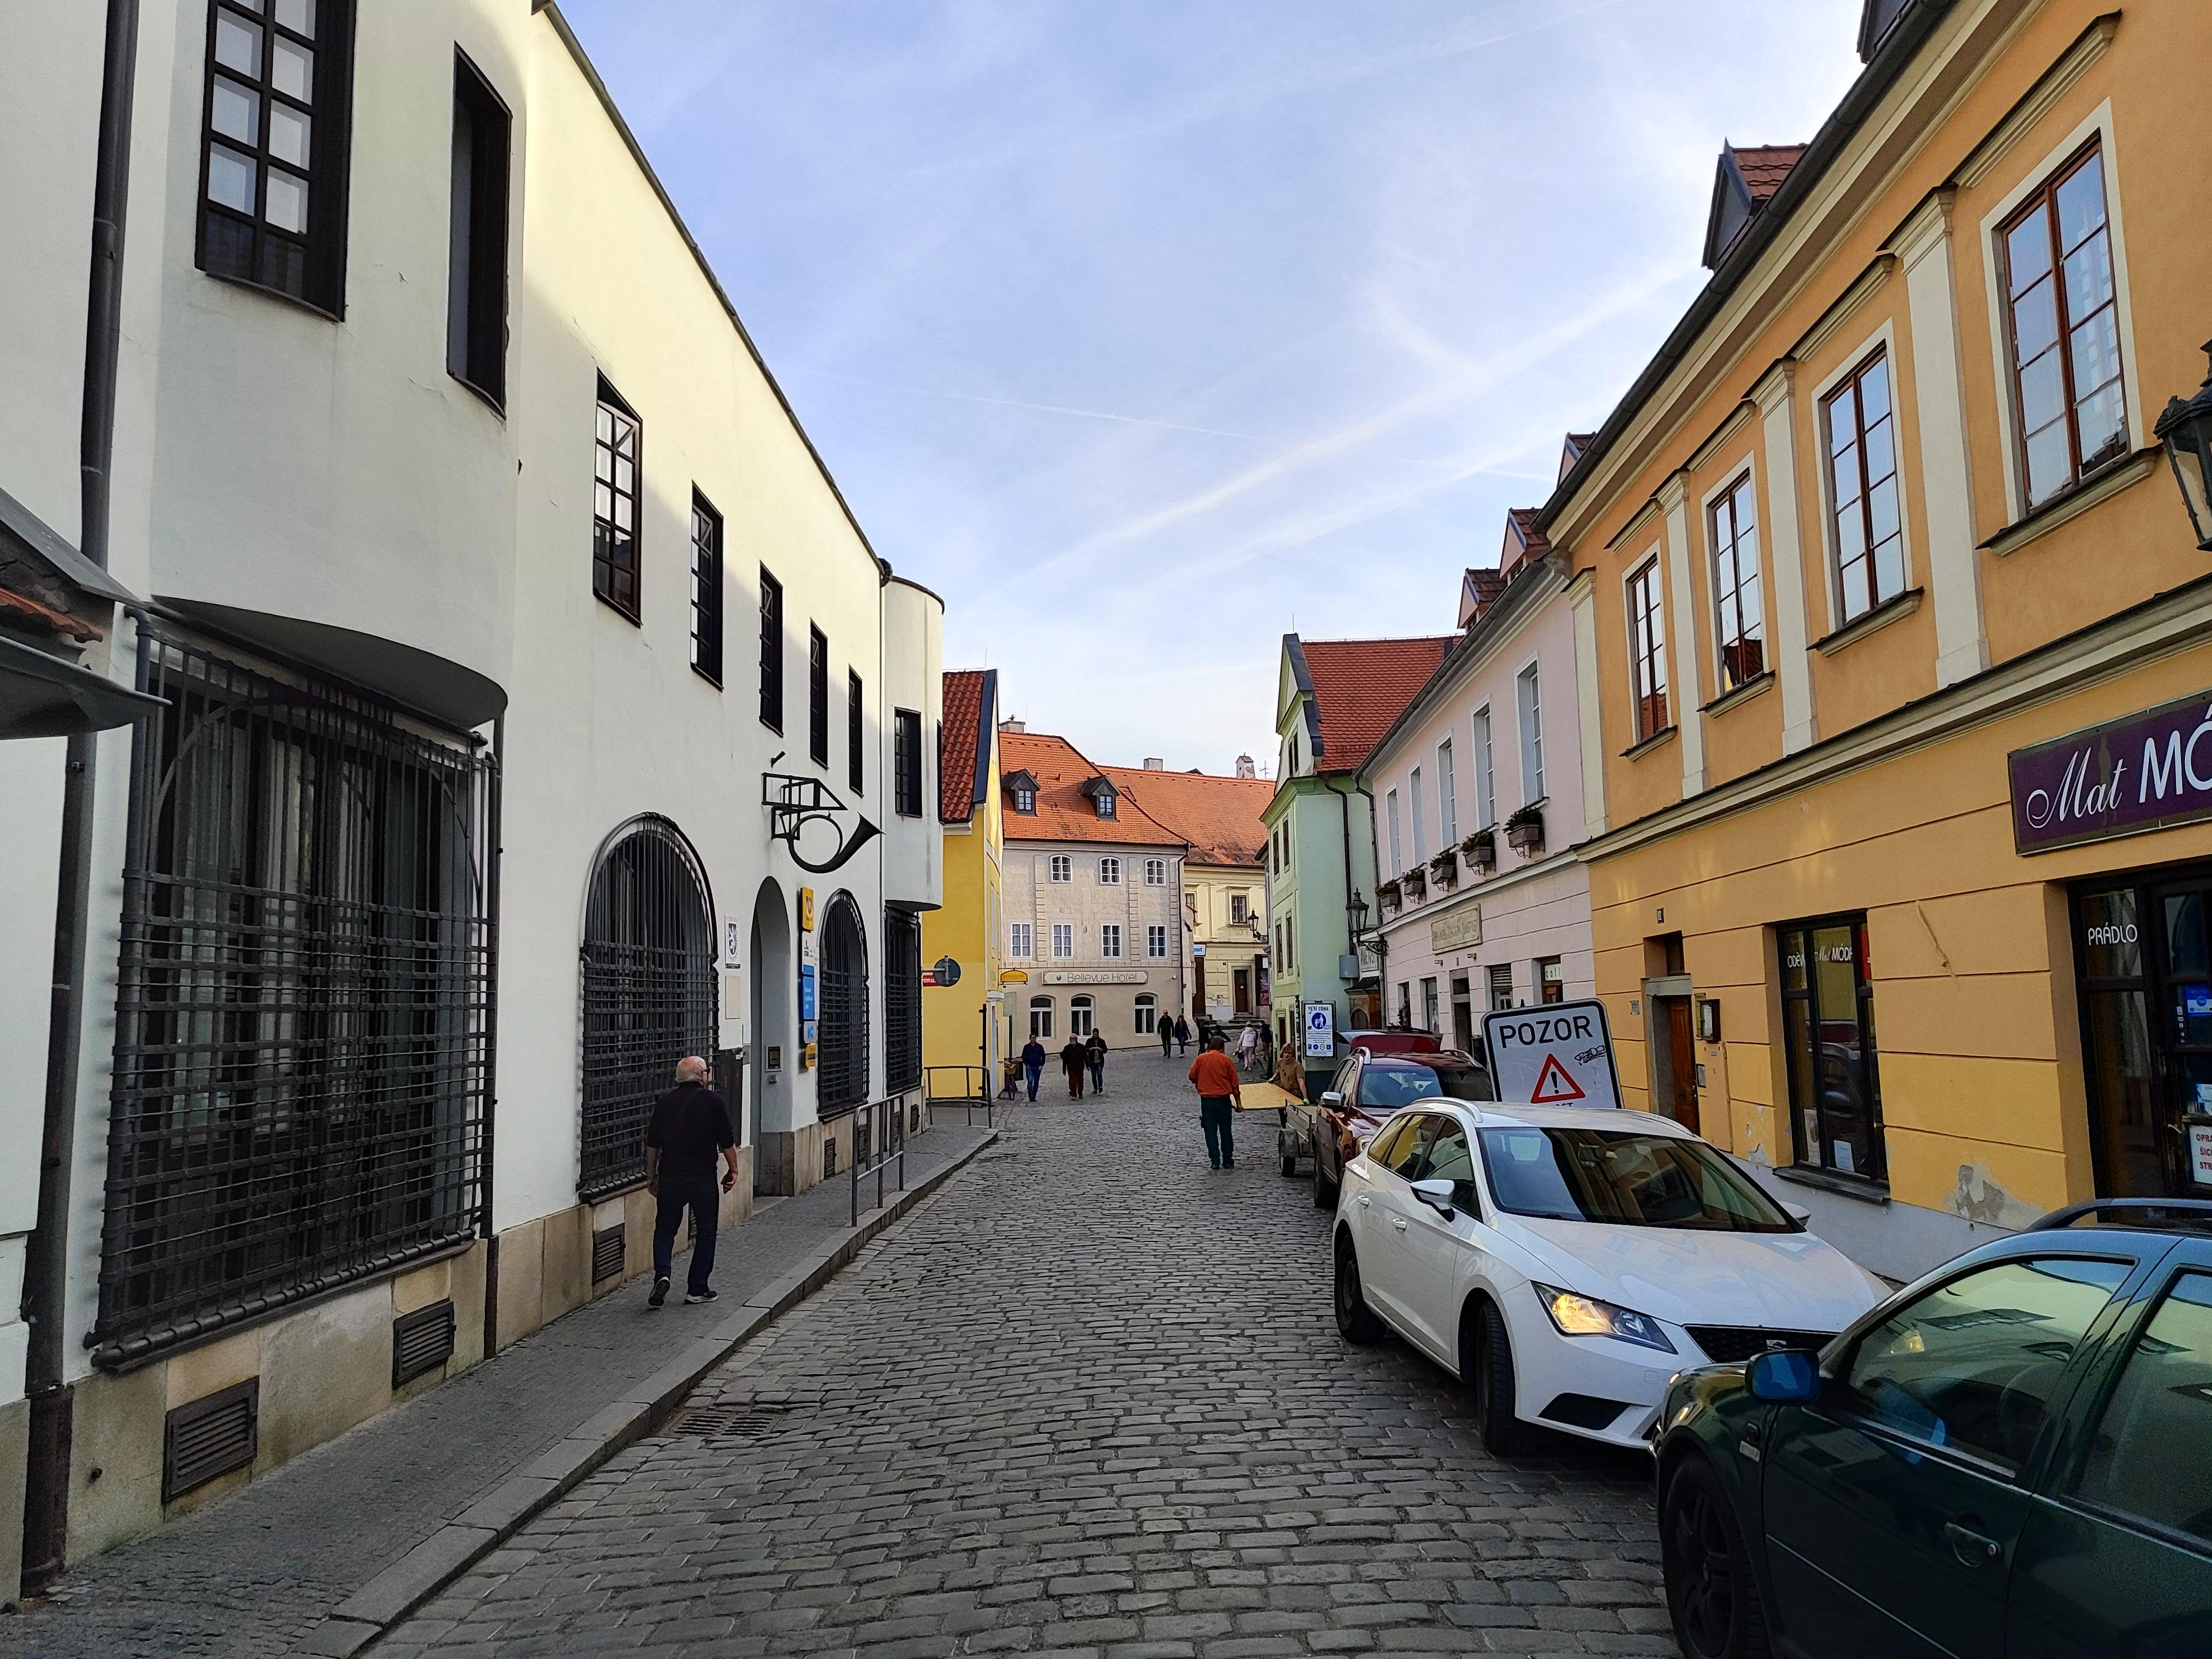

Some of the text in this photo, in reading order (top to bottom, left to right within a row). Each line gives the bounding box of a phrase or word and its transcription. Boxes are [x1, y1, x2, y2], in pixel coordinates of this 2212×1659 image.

[2026, 747, 2128, 828] Mat
[2088, 922, 2138, 946] PRÁDLO
[1067, 972, 1137, 983] Bellevue Hotel
[1499, 1015, 1593, 1048] POZOR
